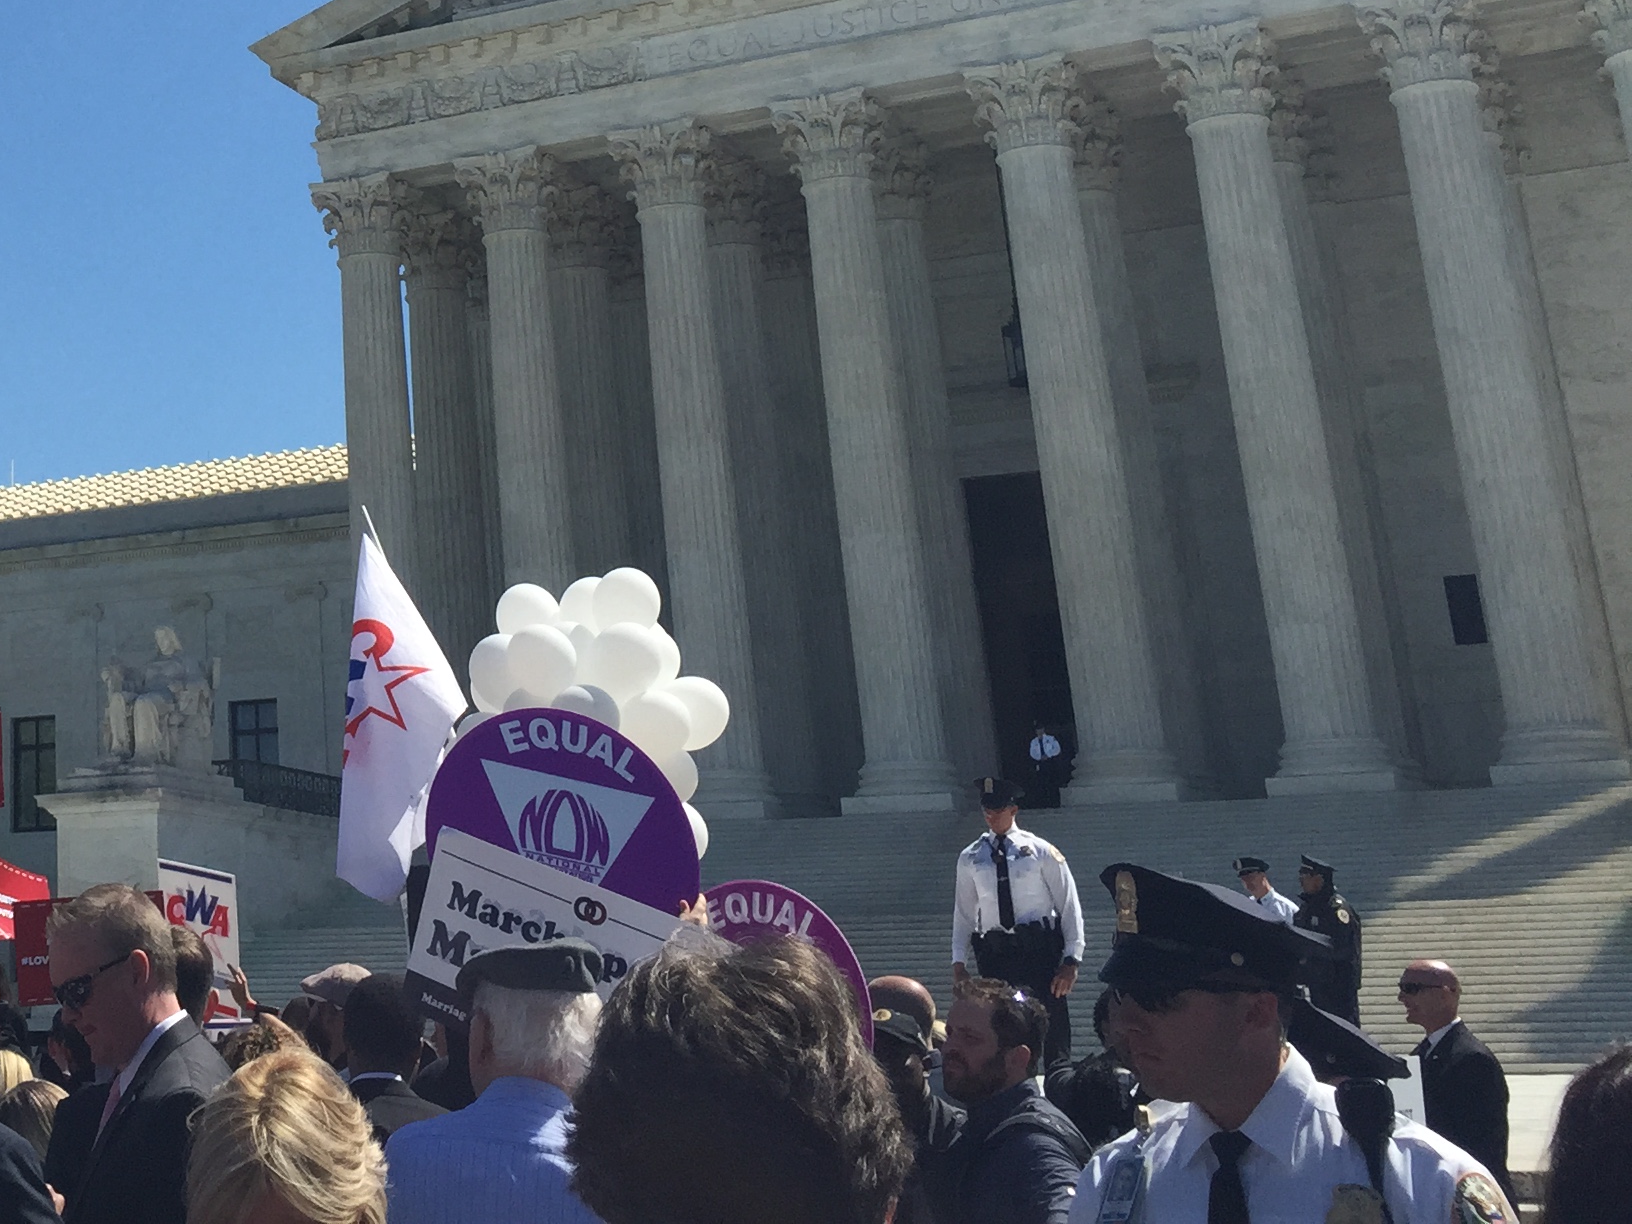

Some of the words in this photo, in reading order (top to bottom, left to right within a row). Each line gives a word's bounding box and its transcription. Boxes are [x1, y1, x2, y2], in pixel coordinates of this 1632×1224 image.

[498, 717, 637, 783] EQUAL
[518, 788, 611, 866] NOW
[166, 885, 230, 938] CWA
[706, 891, 815, 945] EQUAL
